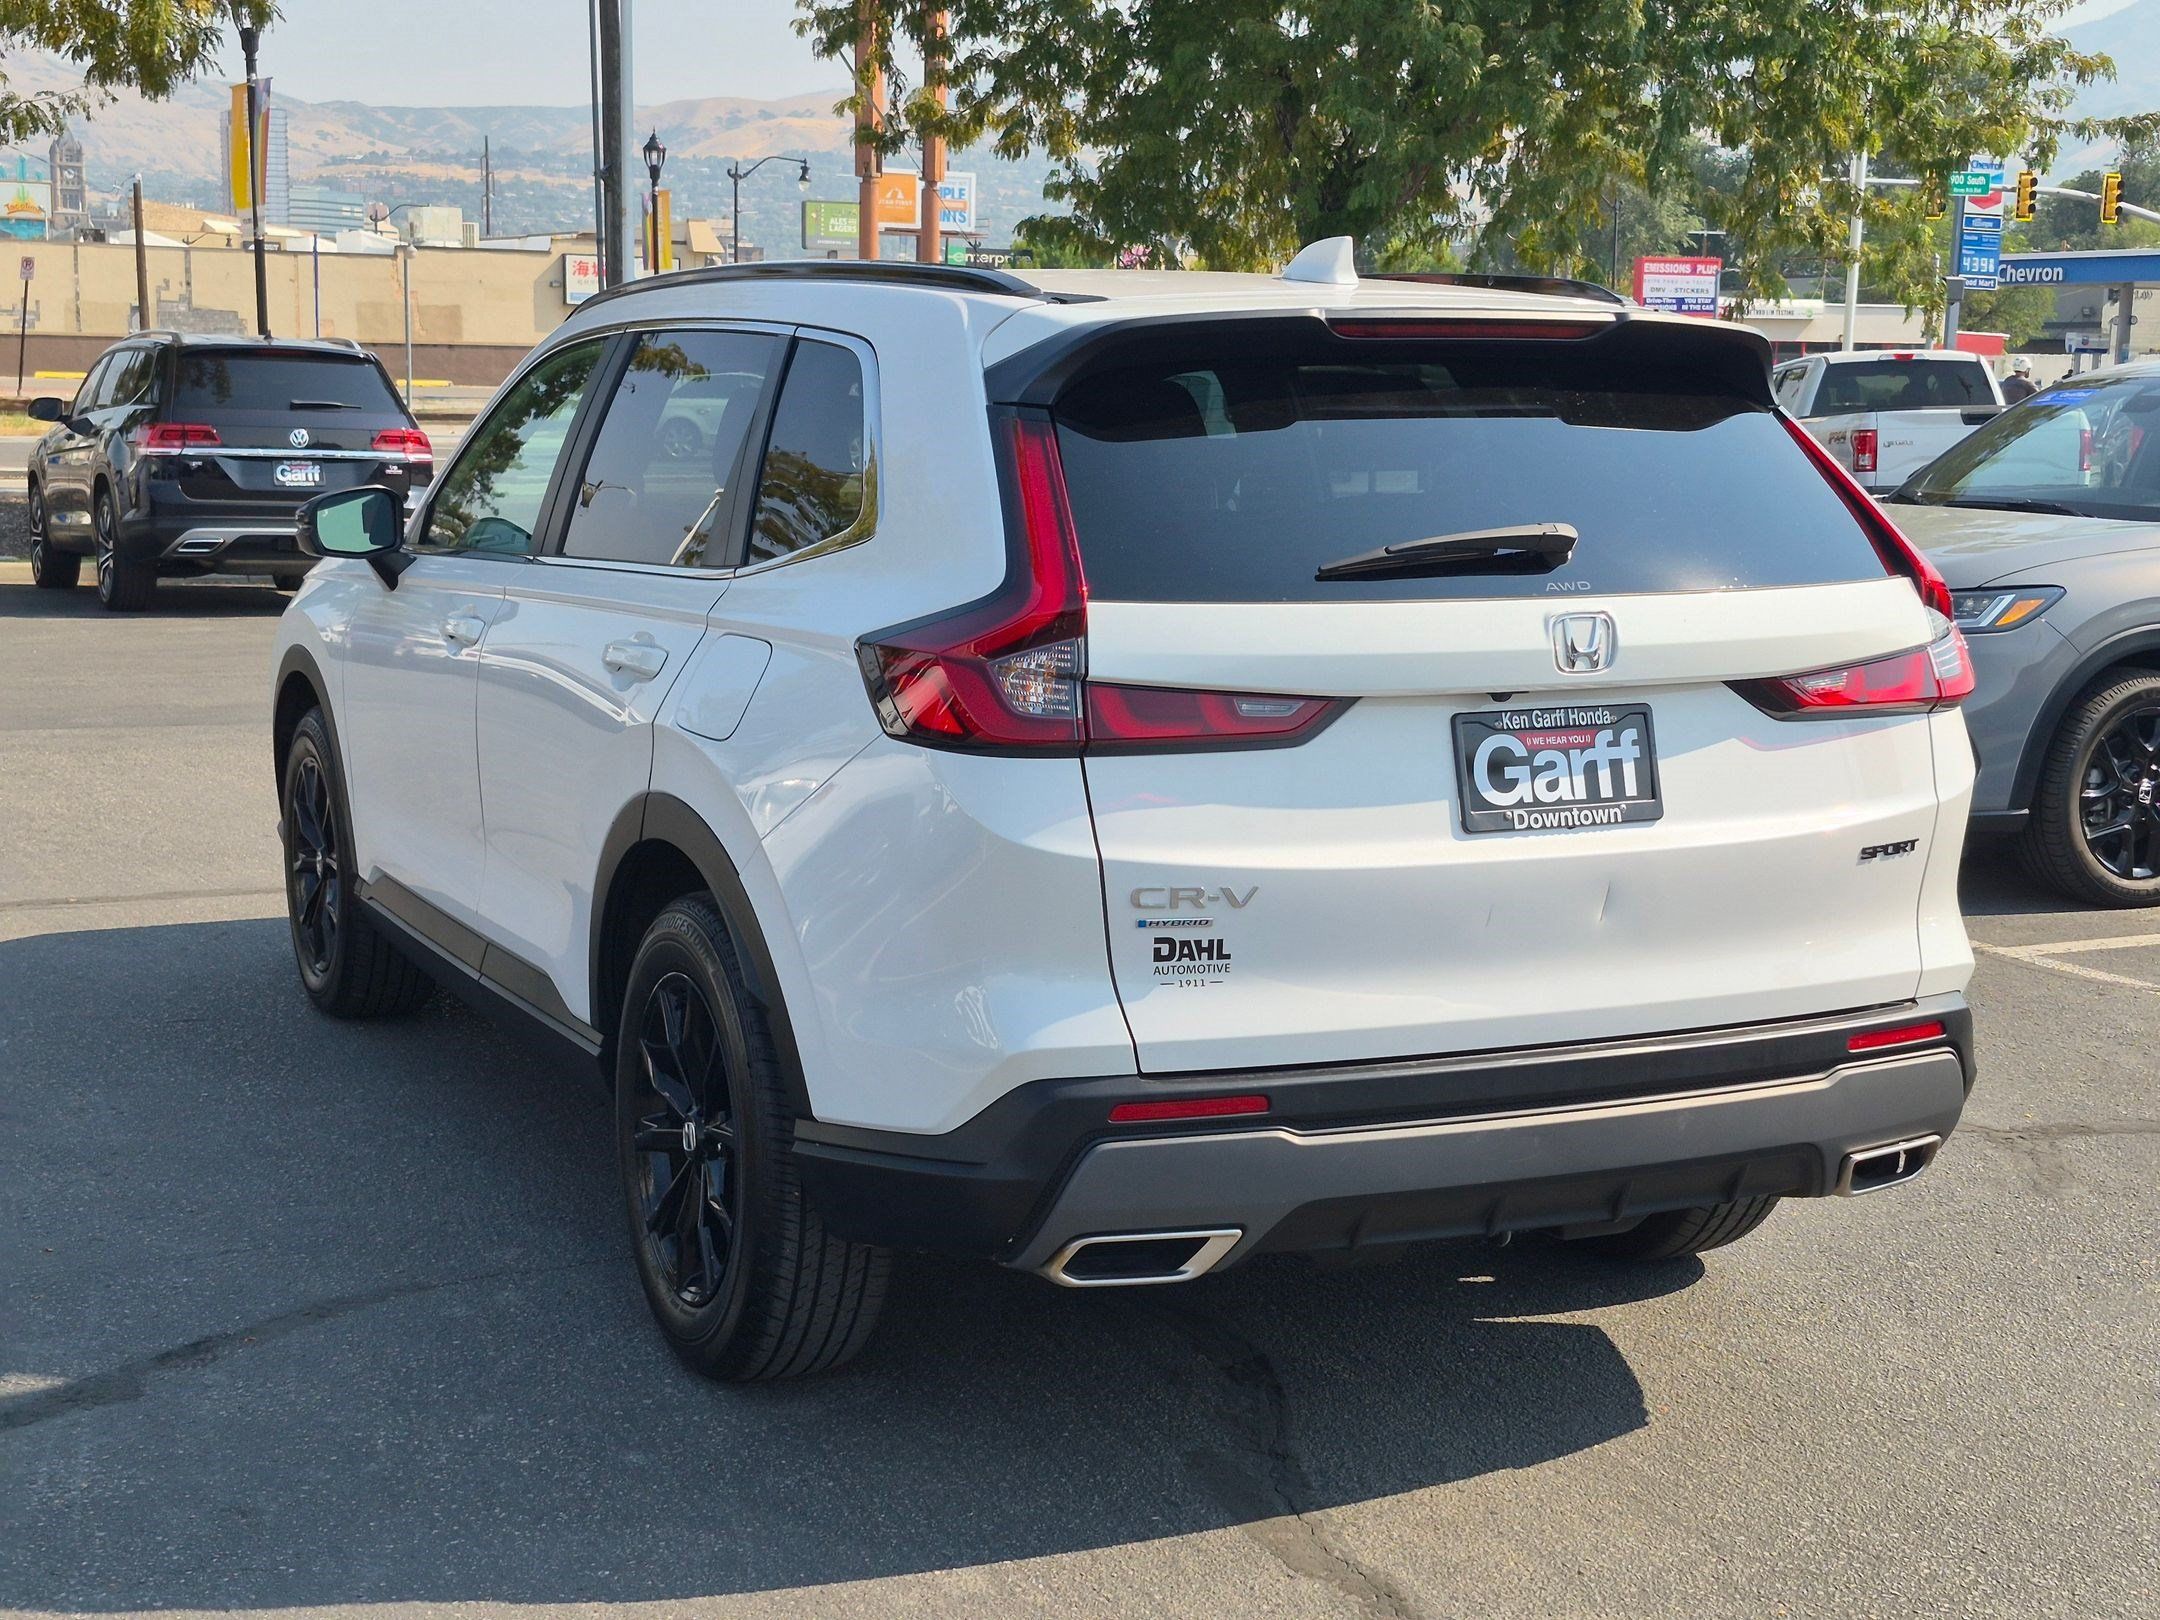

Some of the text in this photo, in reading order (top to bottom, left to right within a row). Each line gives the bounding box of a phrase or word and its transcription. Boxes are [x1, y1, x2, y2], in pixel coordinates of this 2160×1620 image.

[1950, 174, 1986, 185] 900 South
[1644, 262, 1718, 275] EMISSIONS PLUS
[1997, 263, 2063, 283] Chevron
[1978, 279, 1994, 287] Mart
[276, 464, 321, 482] Garff
[1545, 581, 1592, 592] AWD
[1501, 707, 1611, 731] Ken Garff Honda
[1532, 735, 1585, 745] WE HEAR YOU
[1473, 728, 1641, 807] Garff
[1512, 807, 1623, 831] Downtown
[1860, 838, 1920, 860] SPORT
[1130, 886, 1259, 910] CR-V
[1148, 919, 1210, 927] HYBRID
[1153, 937, 1232, 963] DAHL
[1153, 963, 1231, 976] AUTOMOTIVE
[1178, 979, 1206, 988] 1911
